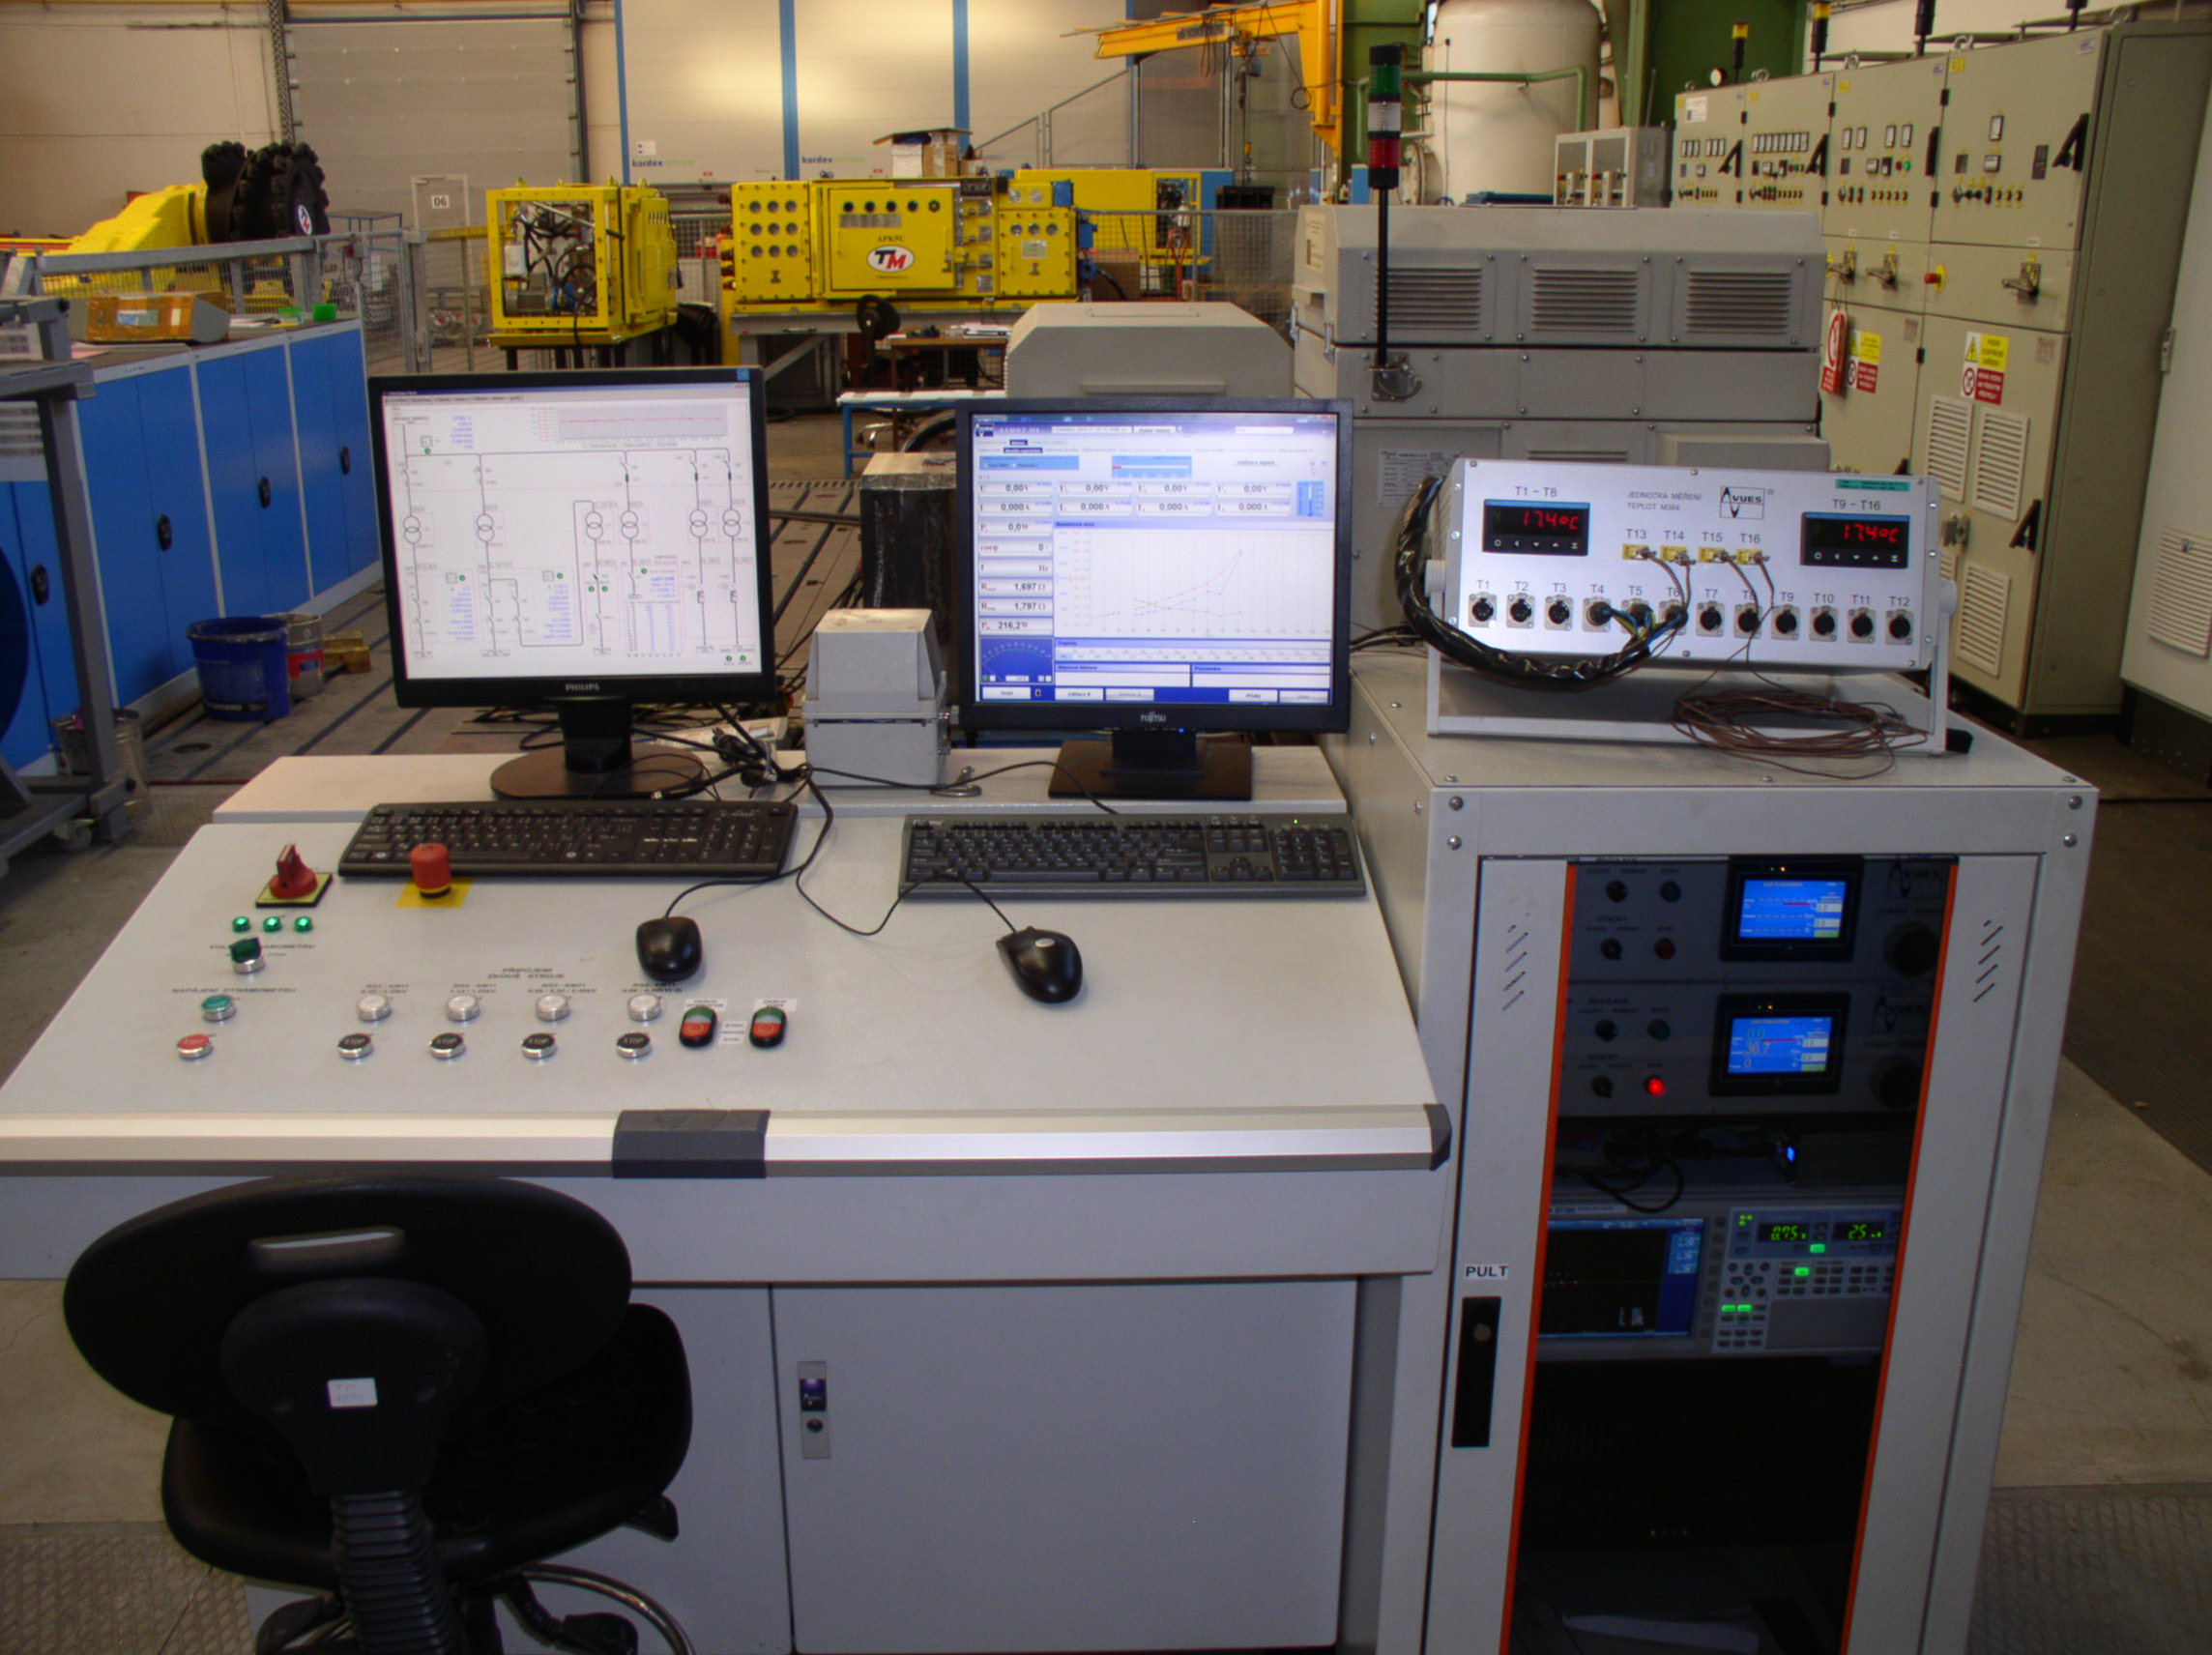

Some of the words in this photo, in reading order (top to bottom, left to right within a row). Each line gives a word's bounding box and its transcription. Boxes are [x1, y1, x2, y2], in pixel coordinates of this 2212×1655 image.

[434, 196, 448, 207] 06
[875, 249, 907, 270] TM
[1515, 486, 1528, 496] T1
[1543, 487, 1557, 497] T8
[1626, 491, 1669, 500] JEDNOTKA
[1626, 502, 1657, 510] TEPLOT
[1832, 499, 1846, 509] T9
[1860, 500, 1881, 510] T16
[1626, 529, 1646, 539] T13
[1664, 530, 1684, 540] T14
[1702, 532, 1723, 542] T15
[1739, 534, 1761, 544] T16
[1014, 583, 1036, 592] 1,697
[1476, 580, 1490, 590] T1
[1514, 581, 1528, 591] T2
[1553, 583, 1567, 593] T3
[1590, 584, 1605, 594] T4
[1629, 585, 1644, 595] T5
[1666, 587, 1681, 597] T6
[1703, 589, 1718, 598] T7
[1780, 592, 1794, 602] T9
[1814, 593, 1835, 603] T10
[1852, 595, 1870, 605] T11
[1889, 596, 1910, 607] T12
[1014, 602, 1036, 611] 1,797
[998, 622, 1022, 631] 216,2
[1141, 711, 1167, 723] FUJITSU
[344, 1037, 366, 1046] STOP
[436, 1037, 458, 1046] STOP
[623, 1036, 645, 1045] STOP
[1466, 1265, 1509, 1277] PULT
